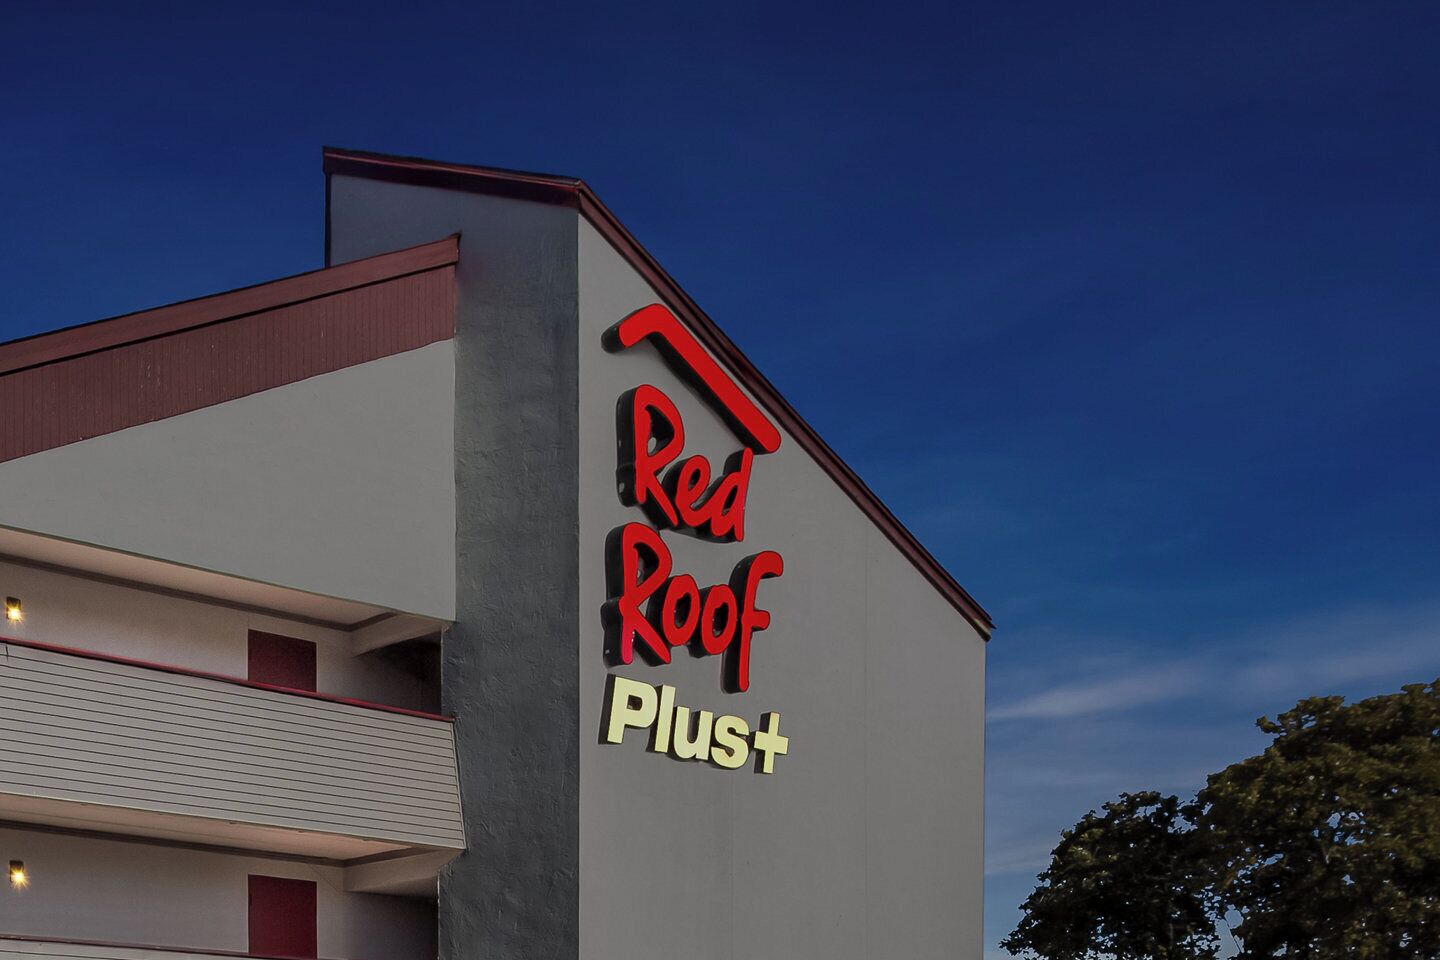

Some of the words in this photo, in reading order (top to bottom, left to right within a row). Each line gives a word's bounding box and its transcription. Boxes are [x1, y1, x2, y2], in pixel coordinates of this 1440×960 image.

[633, 384, 753, 542] Red
[618, 522, 784, 693] Roof
[605, 675, 790, 775] Plus+
